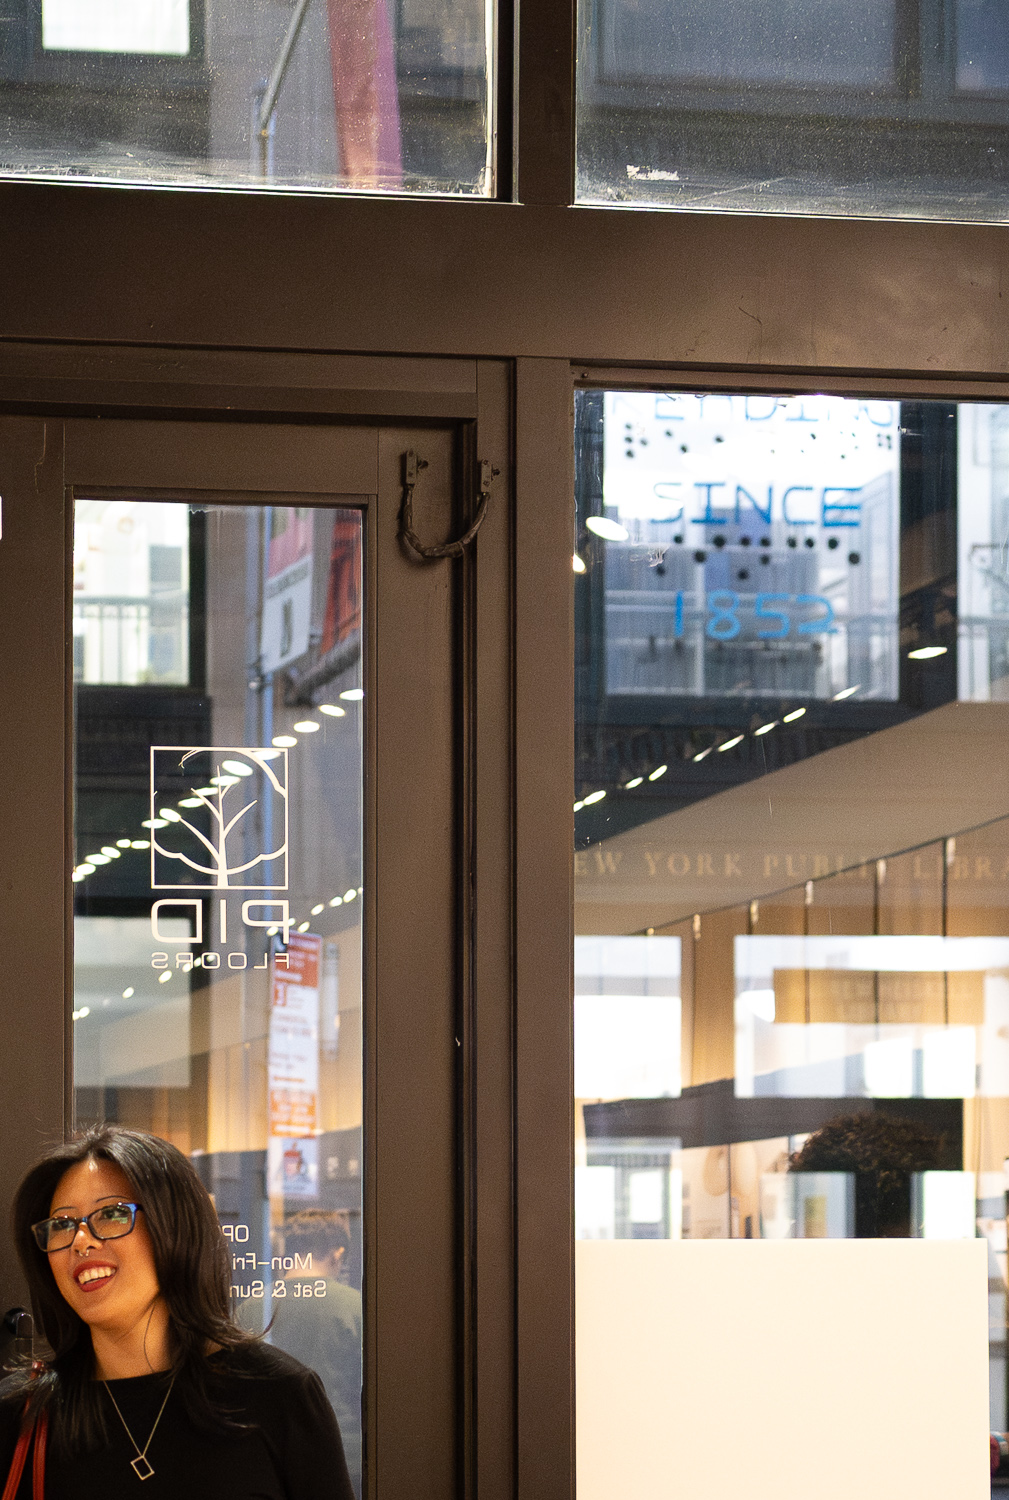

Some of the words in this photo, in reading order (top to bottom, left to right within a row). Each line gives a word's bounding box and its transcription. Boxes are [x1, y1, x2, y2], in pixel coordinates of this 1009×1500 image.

[651, 482, 862, 528] SINCE
[673, 588, 839, 640] 1852
[644, 851, 742, 877] YORK
[763, 854, 887, 879] PUBLI
